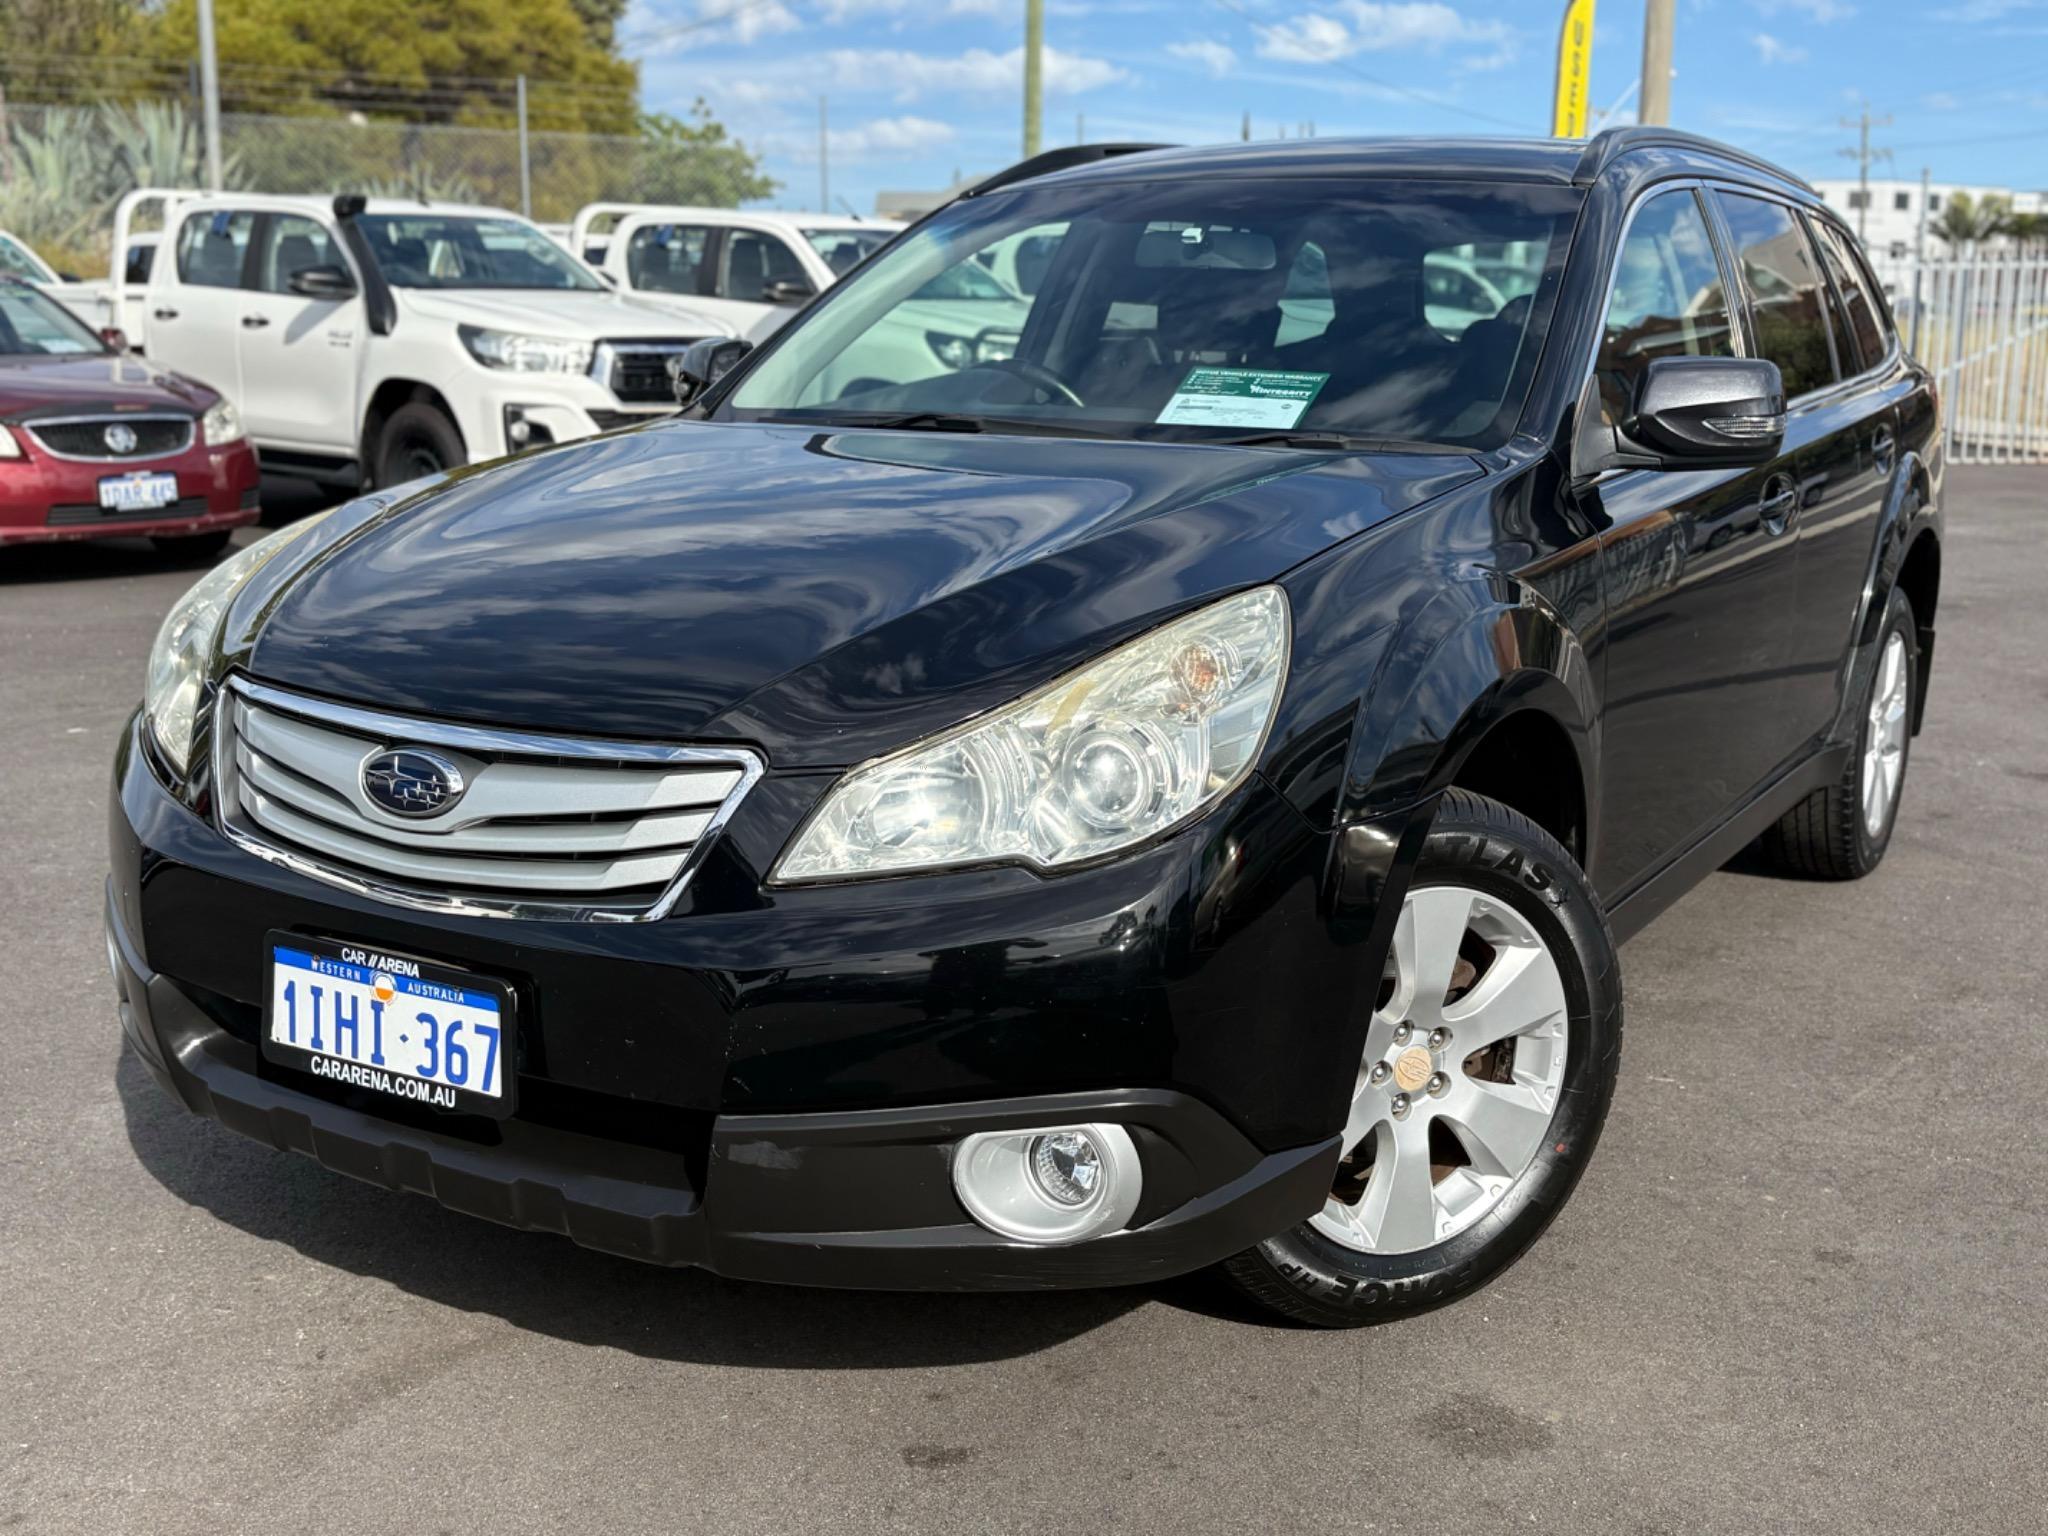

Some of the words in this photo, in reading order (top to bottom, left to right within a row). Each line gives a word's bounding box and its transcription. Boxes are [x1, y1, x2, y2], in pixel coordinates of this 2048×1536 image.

[310, 959, 361, 981] WESTERN
[407, 982, 465, 1004] AUSTRALIA
[310, 1056, 456, 1108] CARARENA.COM.AU
